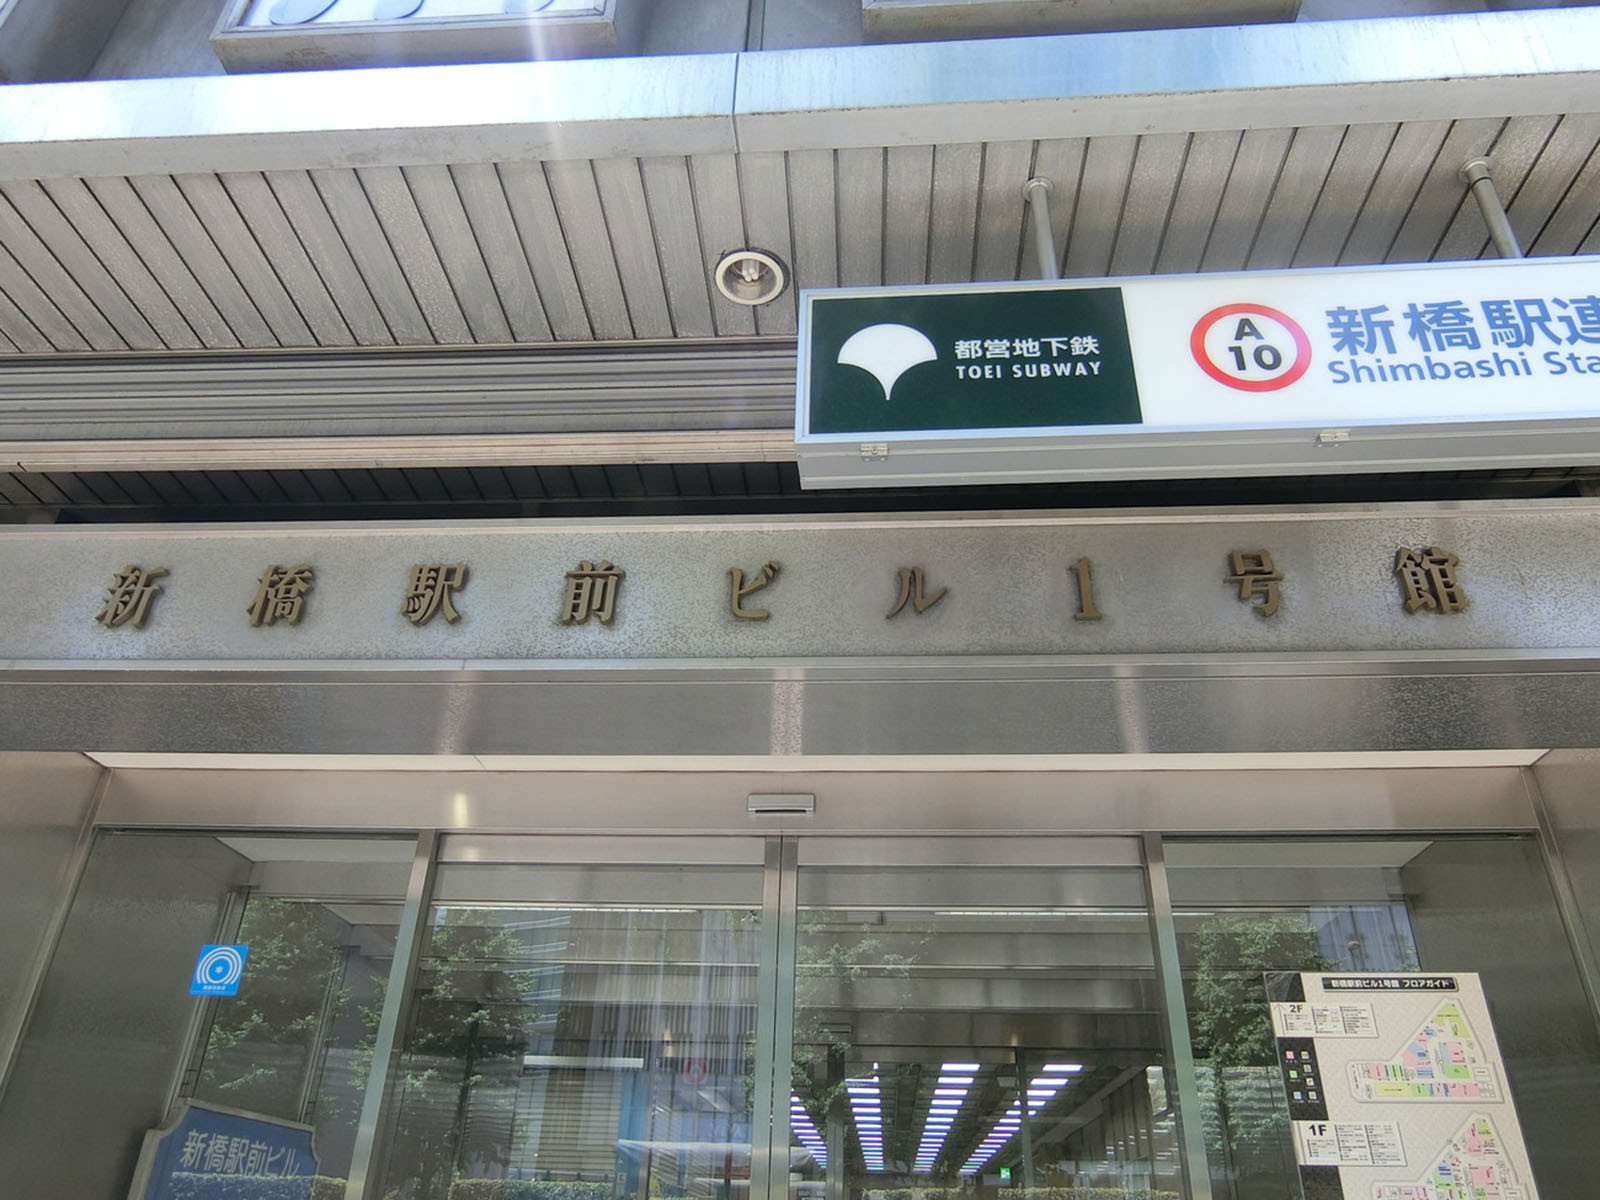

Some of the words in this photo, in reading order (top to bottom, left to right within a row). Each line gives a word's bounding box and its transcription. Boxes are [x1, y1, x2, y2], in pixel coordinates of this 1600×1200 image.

[1234, 318, 1264, 341] A
[954, 335, 1100, 360] 都営地下鉄
[1228, 344, 1282, 371] 10
[955, 365, 1002, 379] TOEI
[1012, 361, 1101, 378] SUBWAY
[1327, 352, 1532, 384] Shimbashi
[96, 546, 1466, 628] 新橋駅前ビル1号館
[1289, 1004, 1303, 1013] 2F
[1308, 1124, 1327, 1136] 1F
[180, 1129, 300, 1177] 新橋駅前ビル
